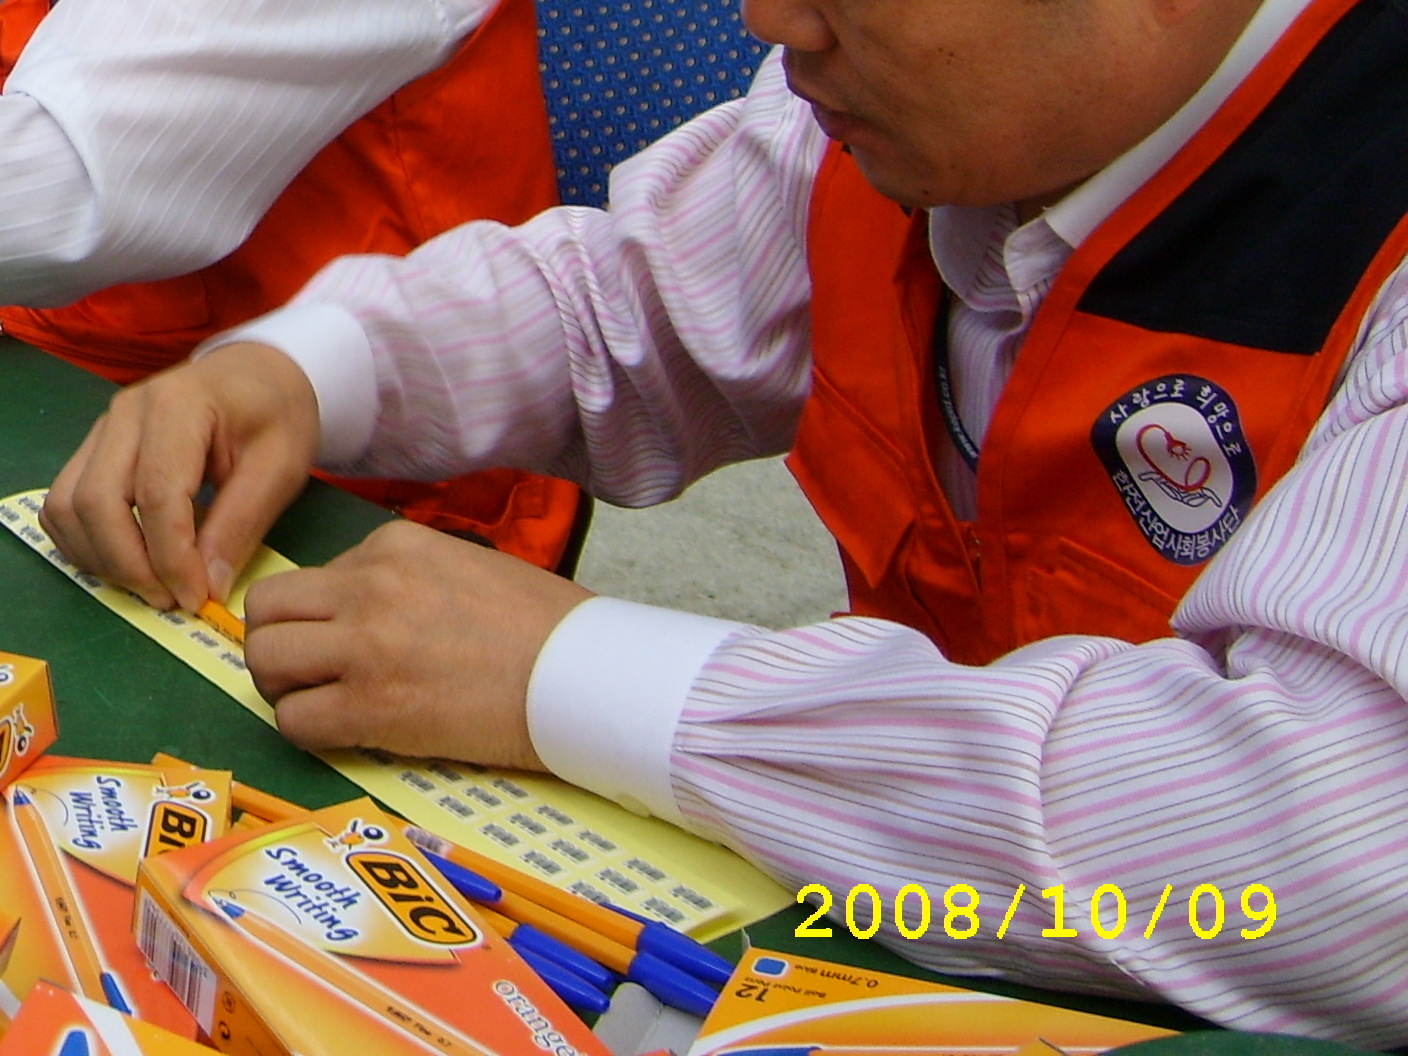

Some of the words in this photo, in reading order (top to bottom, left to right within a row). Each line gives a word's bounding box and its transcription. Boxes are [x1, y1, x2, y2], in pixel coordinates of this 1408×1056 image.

[1110, 379, 1185, 424] 사랑으로
[1197, 385, 1241, 456] 희망으로
[69, 791, 102, 850] Writing
[96, 775, 138, 832] Smooth
[264, 874, 359, 941] Writing
[266, 847, 361, 910] Smooth
[735, 981, 769, 1003] 12
[817, 970, 880, 990] 0.7mm
[494, 980, 574, 1055] orange
